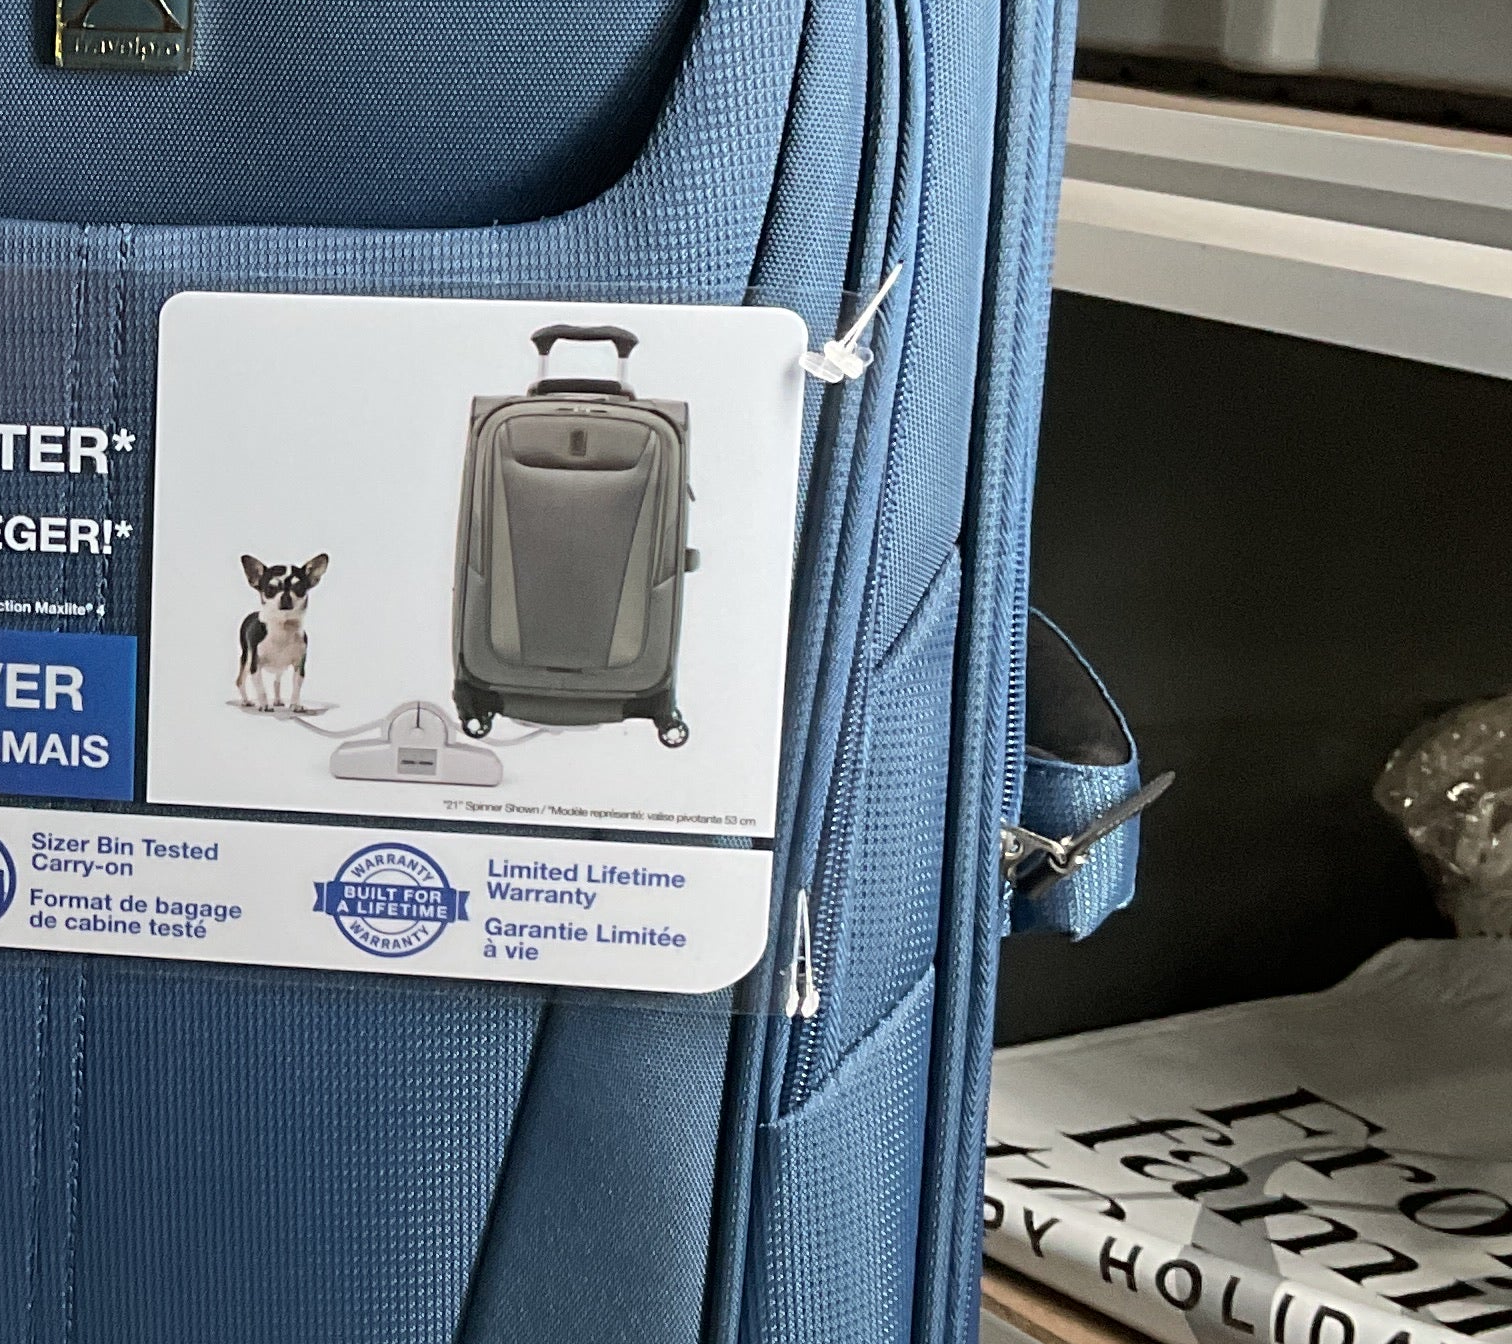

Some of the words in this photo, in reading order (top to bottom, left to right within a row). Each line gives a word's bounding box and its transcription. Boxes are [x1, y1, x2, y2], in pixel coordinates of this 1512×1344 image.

[96, 604, 105, 617] 4
[465, 800, 503, 812] Spinner
[504, 802, 540, 814] Shown
[676, 813, 722, 825] pivotante
[724, 815, 738, 825] 53
[739, 817, 757, 826] cm
[31, 831, 90, 853] Sizer
[97, 835, 134, 856] Bin
[141, 838, 219, 861] Tested
[31, 853, 133, 878] Carry-on
[350, 853, 435, 883] WARRANTY
[487, 858, 578, 882] Limited
[587, 864, 686, 888] Lifetime
[29, 888, 113, 912] Format
[119, 894, 148, 913] de
[155, 896, 243, 923] bagage
[343, 885, 398, 902] BUILT
[403, 889, 442, 904] FOR
[487, 881, 597, 910] Warranty
[336, 899, 349, 913] A
[356, 901, 448, 920] LIFETIME
[29, 910, 58, 929] de
[64, 914, 142, 935] cabine
[149, 918, 207, 939] testé
[349, 919, 430, 950] WARRANTY
[484, 917, 589, 941] Garantie
[596, 924, 687, 948] Limitée
[483, 937, 497, 958] à
[505, 942, 539, 960] vie
[1192, 1084, 1512, 1270] Fro
